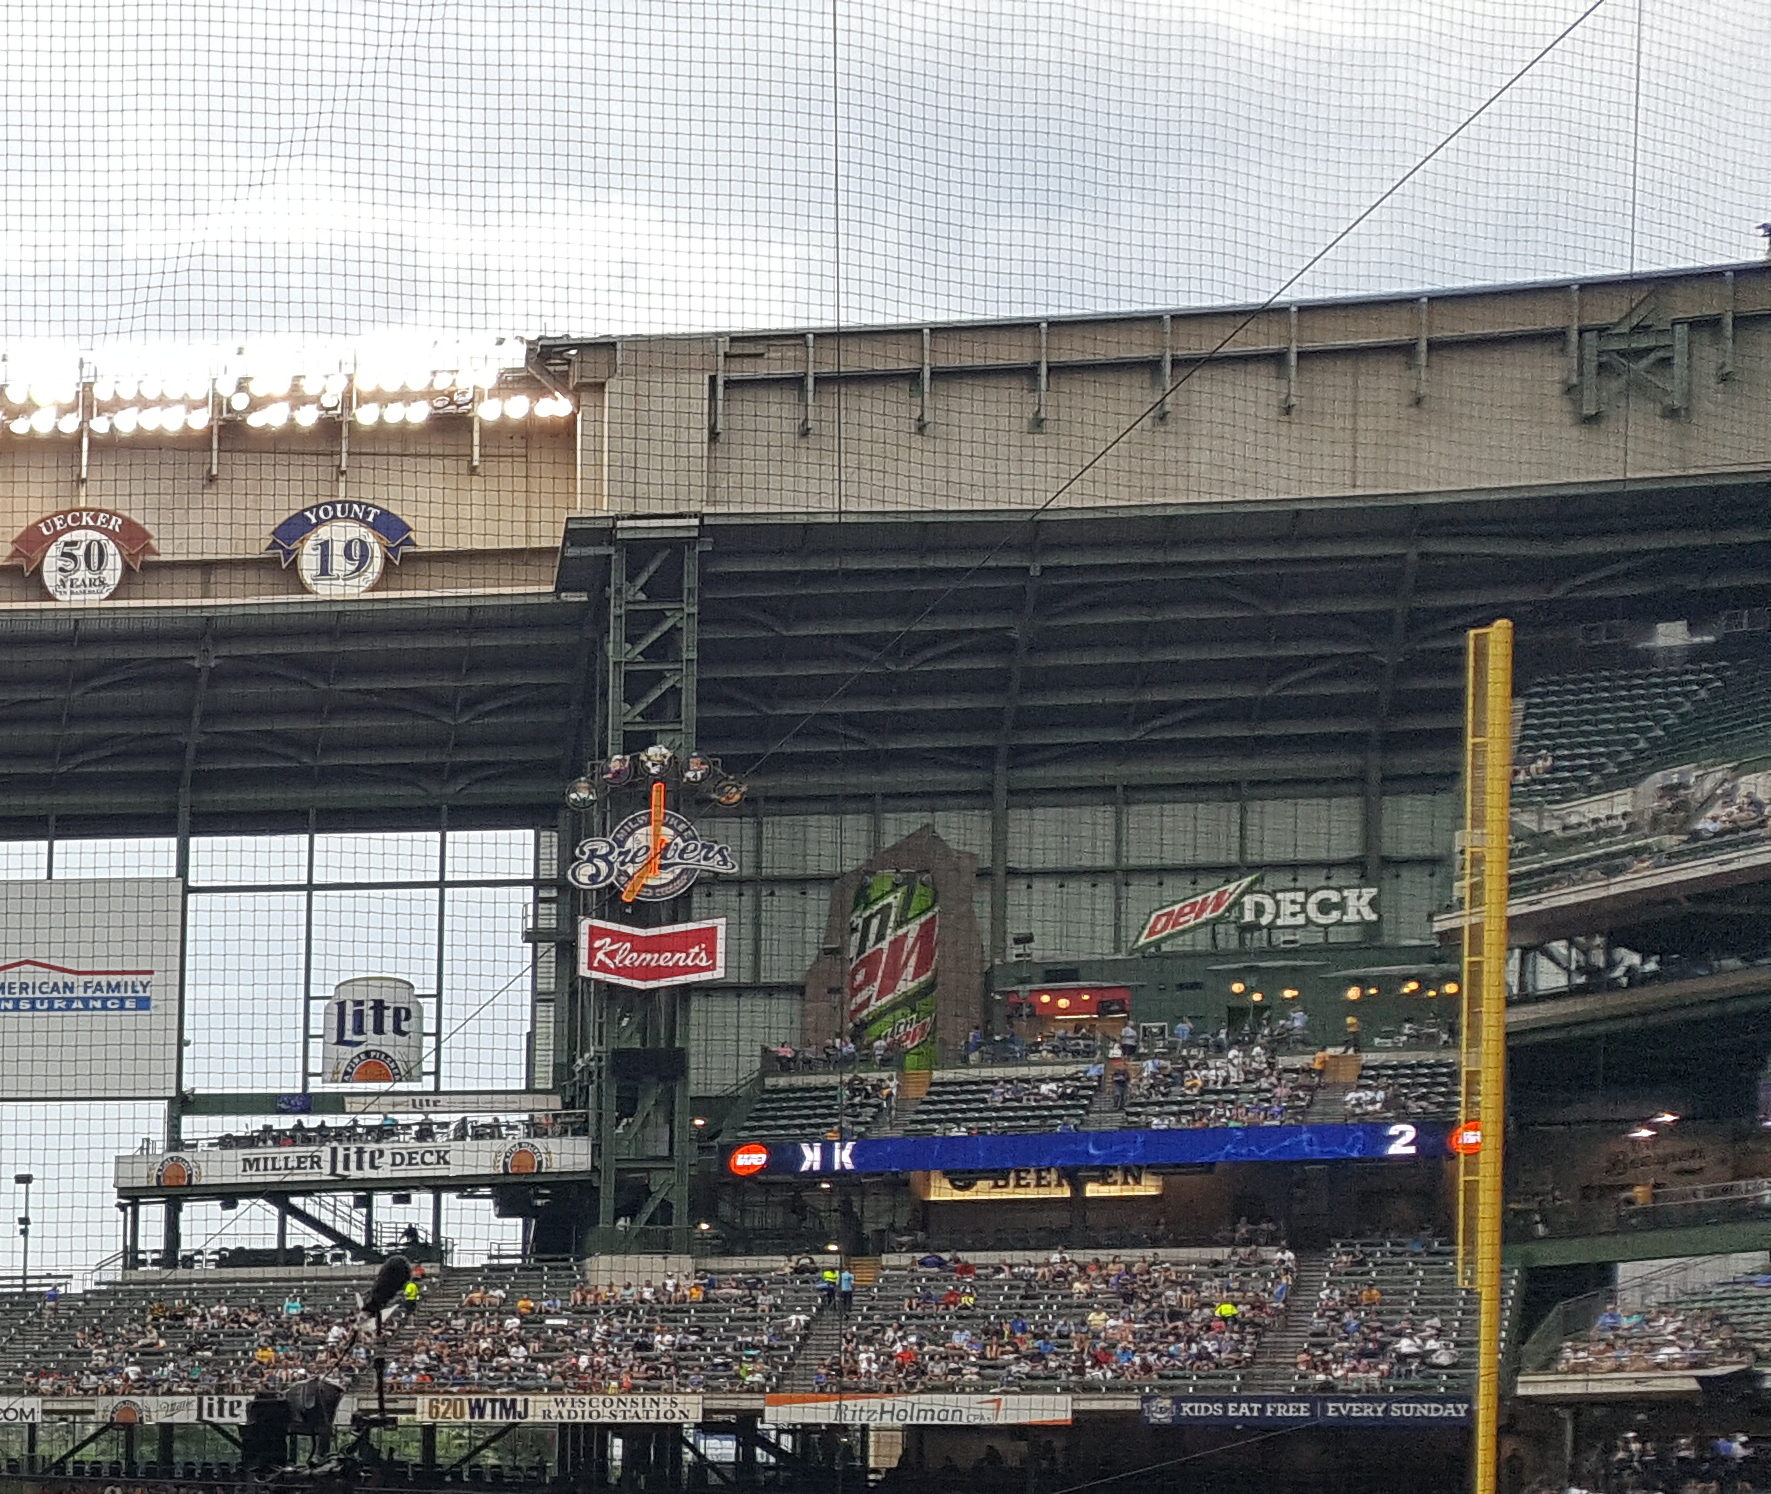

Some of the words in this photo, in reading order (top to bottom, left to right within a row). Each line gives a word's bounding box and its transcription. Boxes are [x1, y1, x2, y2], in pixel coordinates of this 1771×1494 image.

[40, 511, 124, 536] UECKER
[303, 503, 381, 525] YOUNT
[57, 539, 109, 575] 50
[311, 538, 375, 581] 19
[1240, 887, 1379, 927] DECK
[593, 937, 712, 969] Klement's
[83, 980, 150, 997] FAMILY
[333, 999, 412, 1047] Lite
[242, 1155, 322, 1173] MILLER
[327, 1142, 385, 1176] Lite
[391, 1149, 451, 1167] DECK
[835, 1142, 856, 1170] K
[428, 1398, 466, 1421] 620
[468, 1398, 530, 1421] WTMJ
[542, 1408, 590, 1420] RADIO
[598, 1408, 691, 1420] STATION
[553, 1396, 679, 1409] WISCONSIN'S
[833, 1402, 963, 1424] RitzHolman
[1181, 1403, 1222, 1418] KIDS
[1227, 1403, 1260, 1418] EAT
[1265, 1404, 1310, 1419] FREE
[1327, 1404, 1385, 1419] EVERY
[1389, 1404, 1468, 1420] SUNDAY
